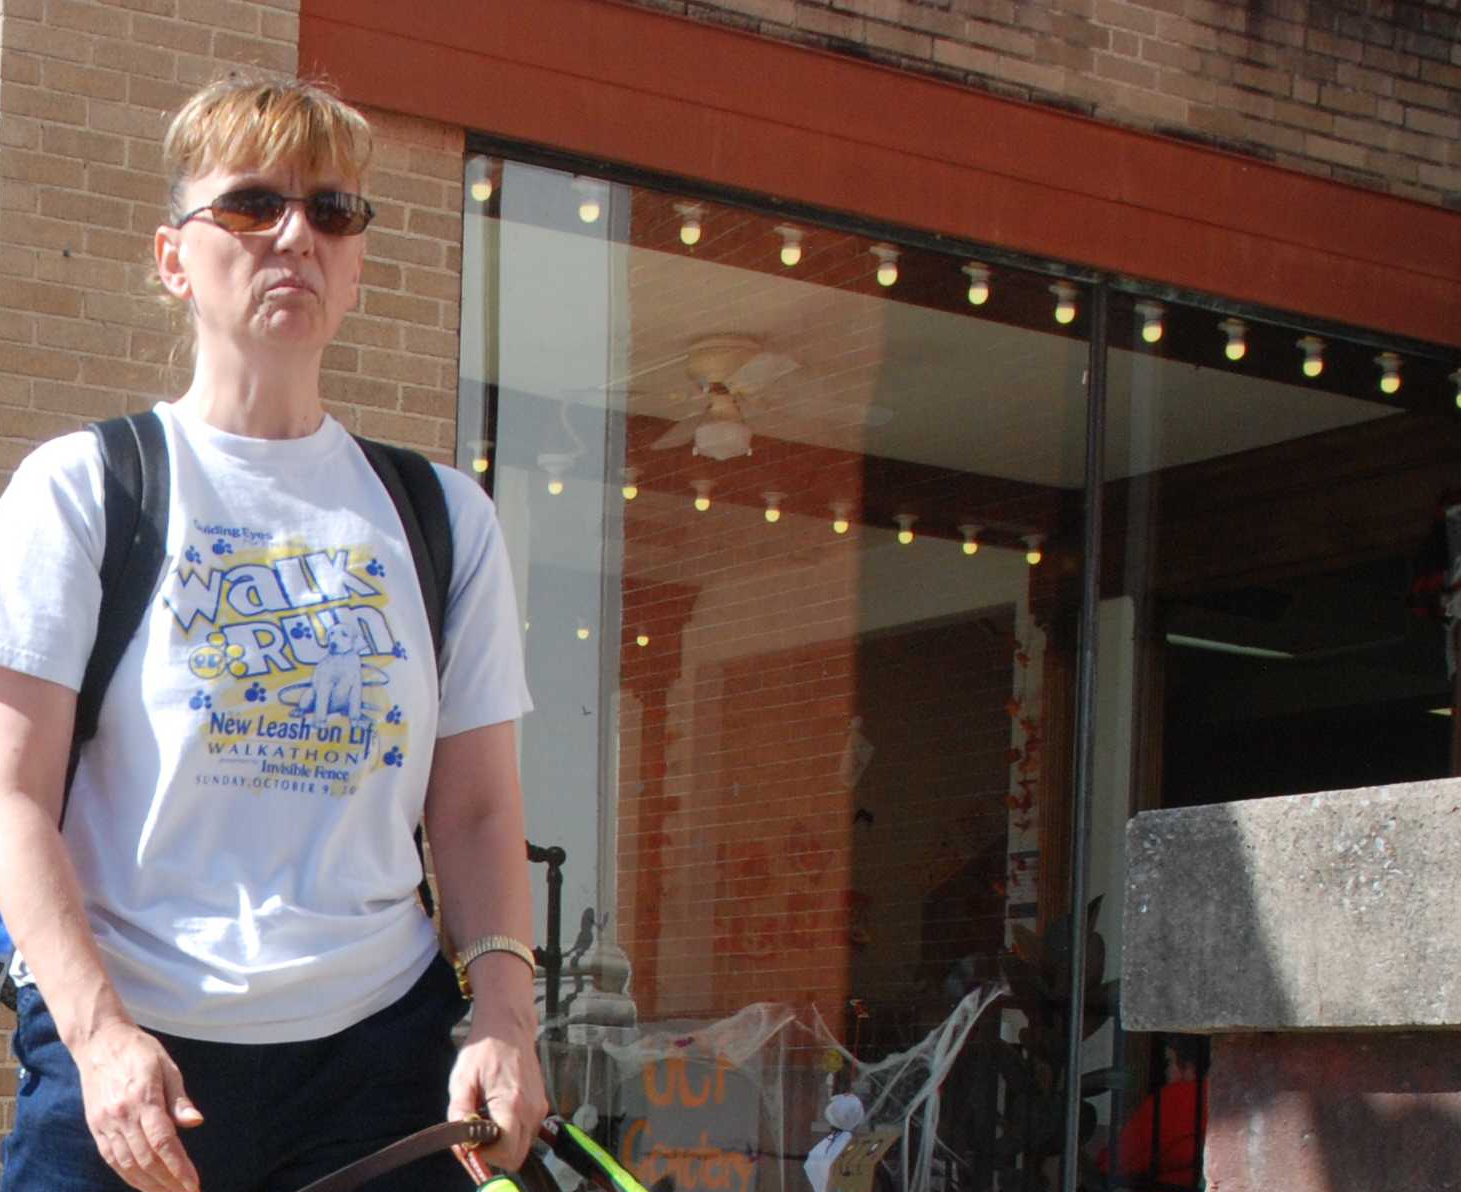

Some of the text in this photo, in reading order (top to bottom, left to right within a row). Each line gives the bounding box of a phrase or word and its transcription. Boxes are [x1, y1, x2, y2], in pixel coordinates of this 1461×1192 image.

[209, 711, 252, 735] New
[257, 715, 311, 741] Leash
[208, 742, 361, 765] WALKATHON
[261, 759, 310, 779] Invisible
[313, 764, 350, 782] Fence
